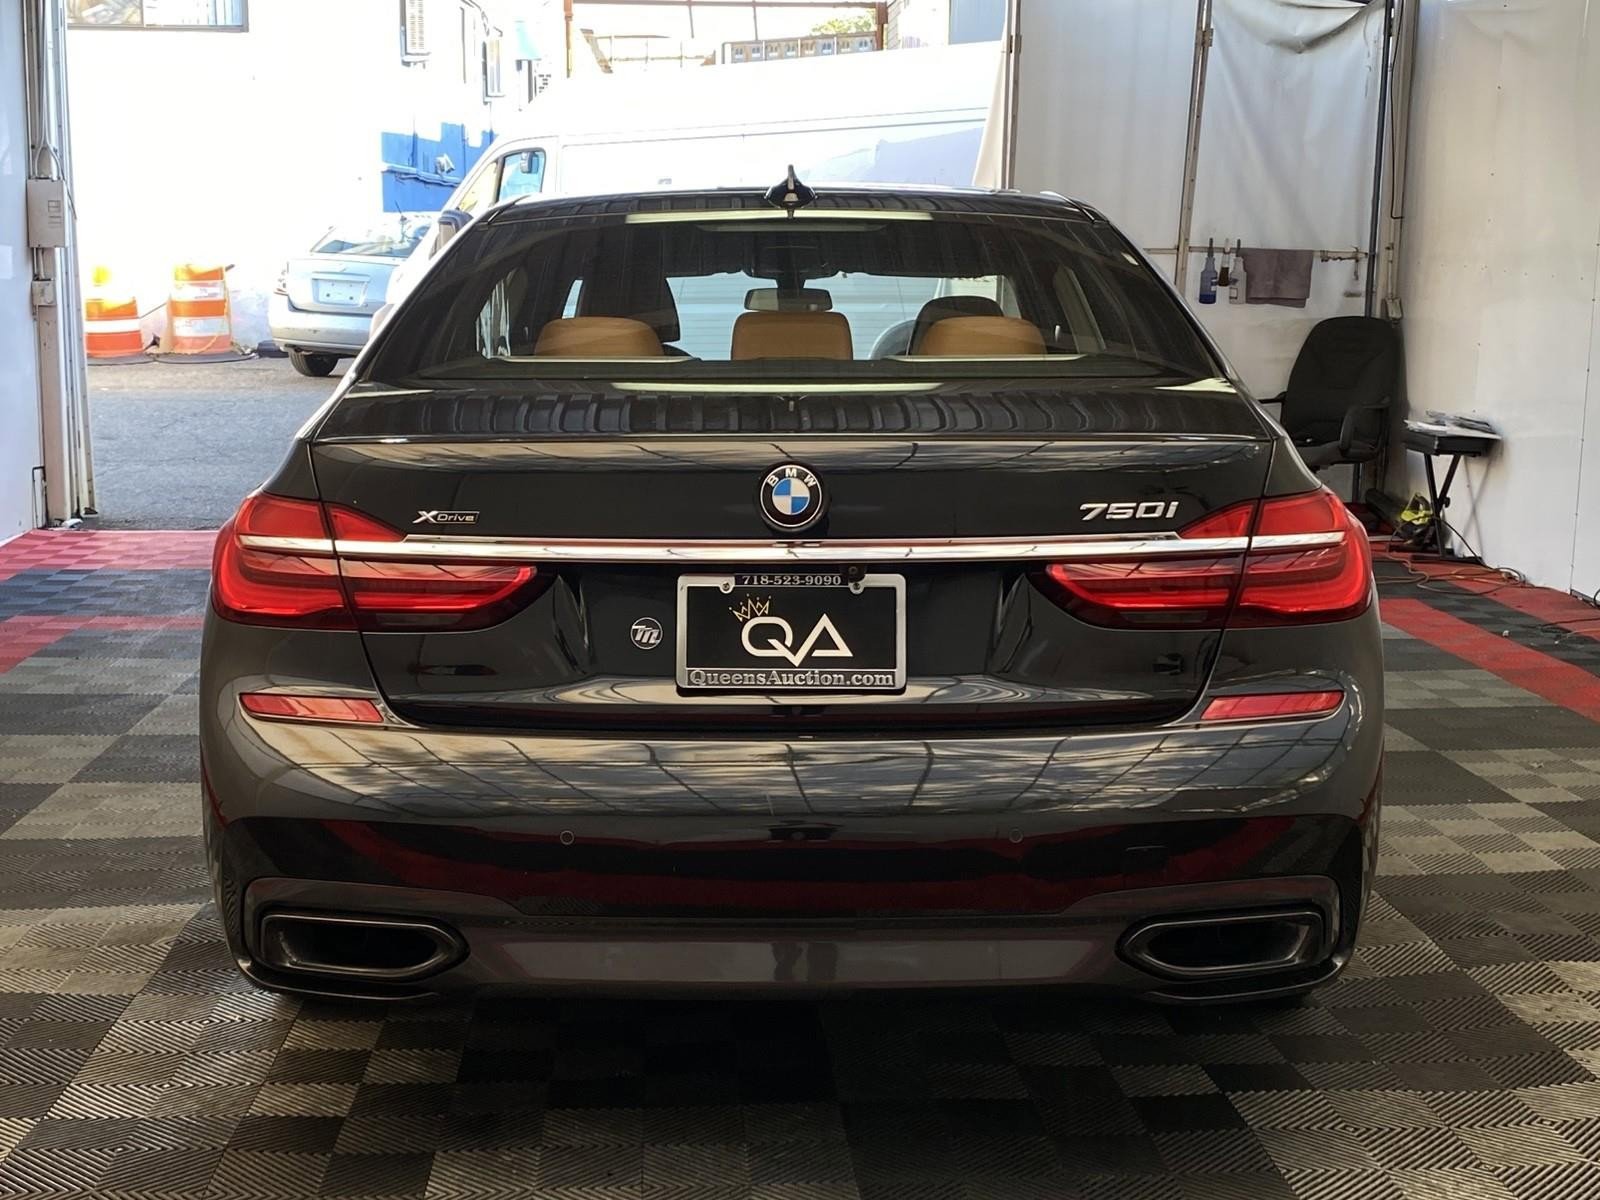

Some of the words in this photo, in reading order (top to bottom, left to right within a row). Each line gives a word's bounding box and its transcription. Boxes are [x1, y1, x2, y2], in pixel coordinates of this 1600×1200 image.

[766, 467, 818, 488] BMW
[742, 575, 842, 586] 718-523-9090
[741, 613, 854, 667] QA
[689, 669, 894, 686] QueensAuction.com
